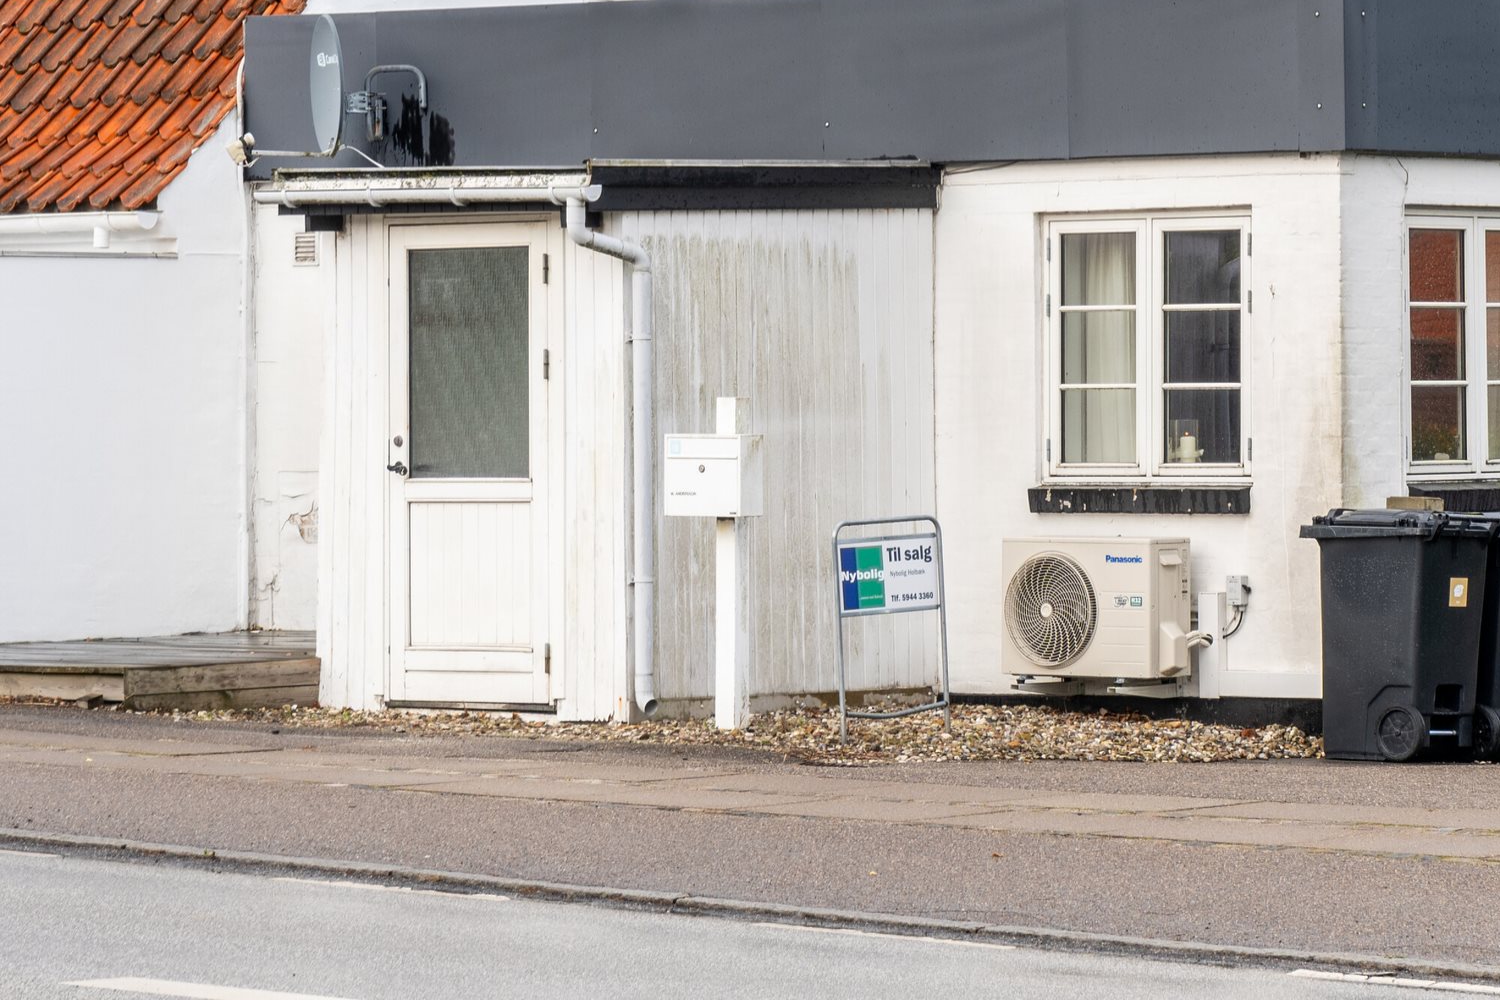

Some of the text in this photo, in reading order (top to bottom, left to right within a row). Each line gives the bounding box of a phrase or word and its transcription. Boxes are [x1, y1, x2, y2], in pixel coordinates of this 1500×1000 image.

[887, 546, 932, 563] Til salg
[1105, 554, 1142, 563] Panasonic
[841, 569, 885, 583] Nybolig
[902, 593, 917, 601] 5944
